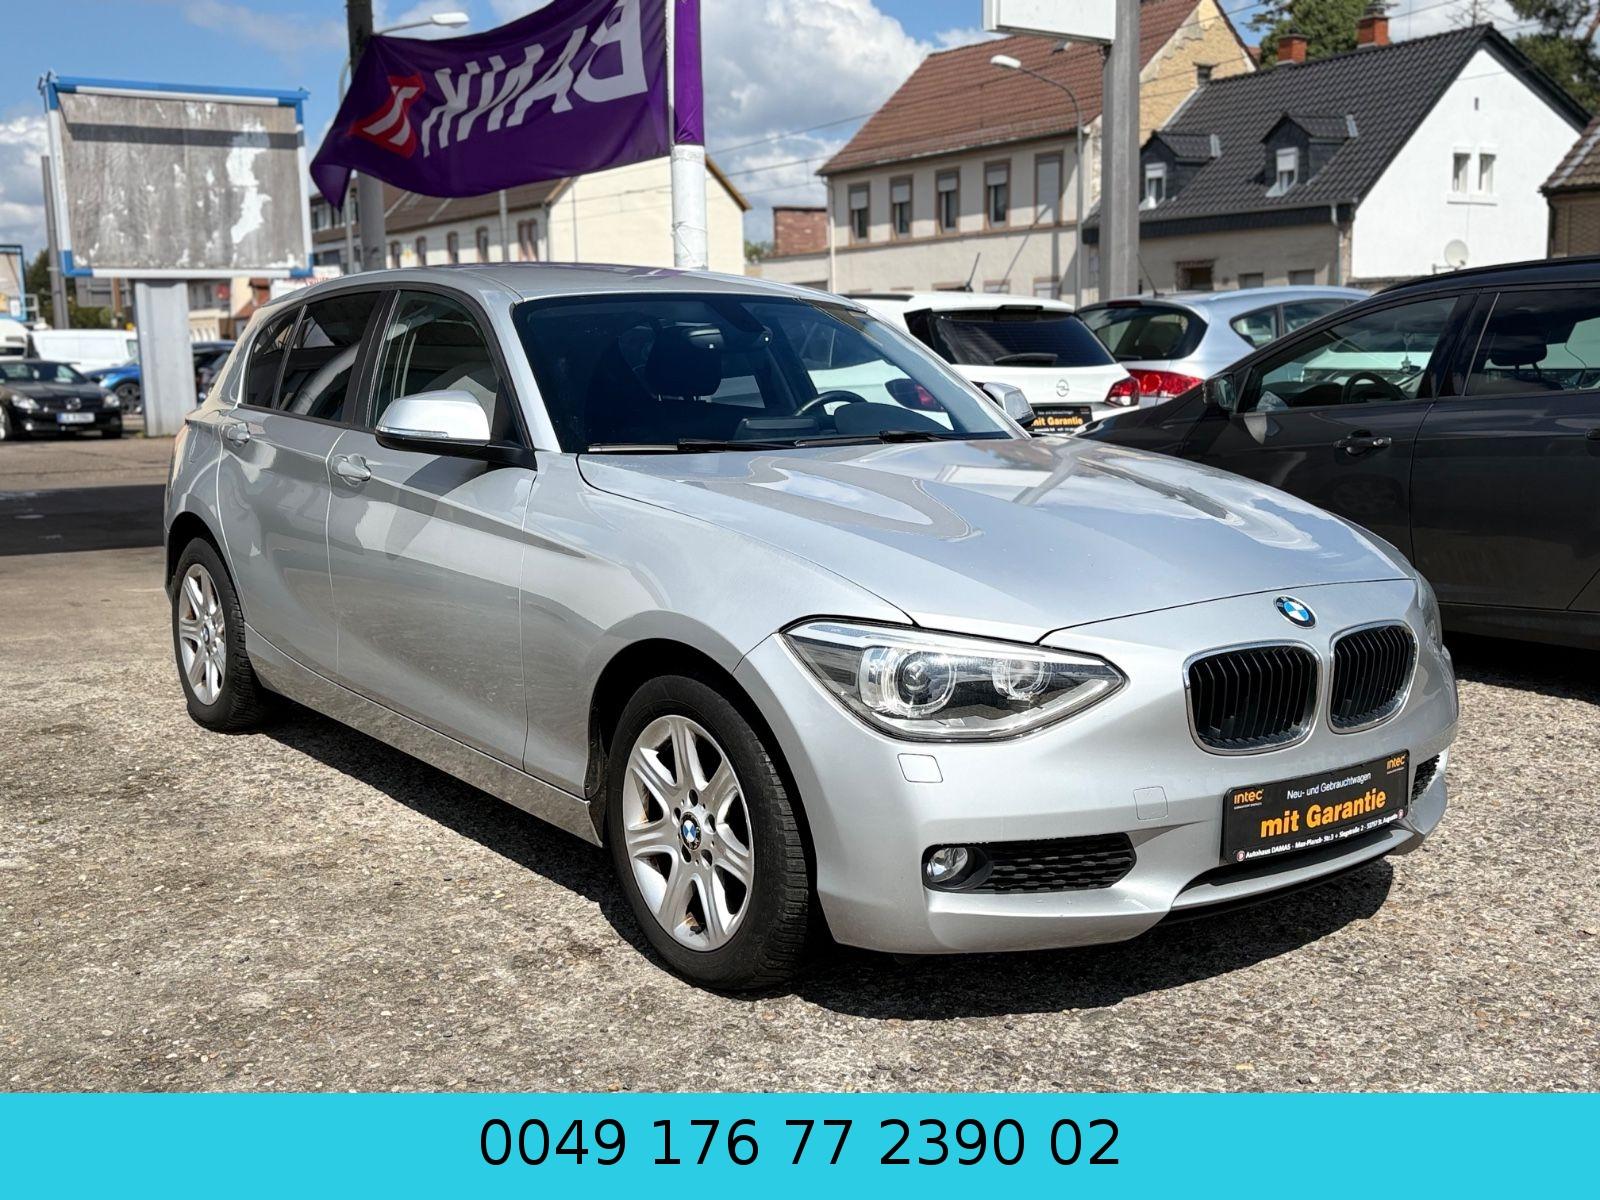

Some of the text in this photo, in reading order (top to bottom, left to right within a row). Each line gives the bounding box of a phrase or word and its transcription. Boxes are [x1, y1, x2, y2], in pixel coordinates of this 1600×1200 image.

[1386, 755, 1405, 770] intec
[1287, 772, 1372, 800] Neu- und Gebrauchtwagen
[1233, 789, 1264, 805] intec
[1260, 787, 1387, 838] mit Garantie
[1245, 848, 1271, 858] Autohaus
[1271, 844, 1291, 853] DAMAS
